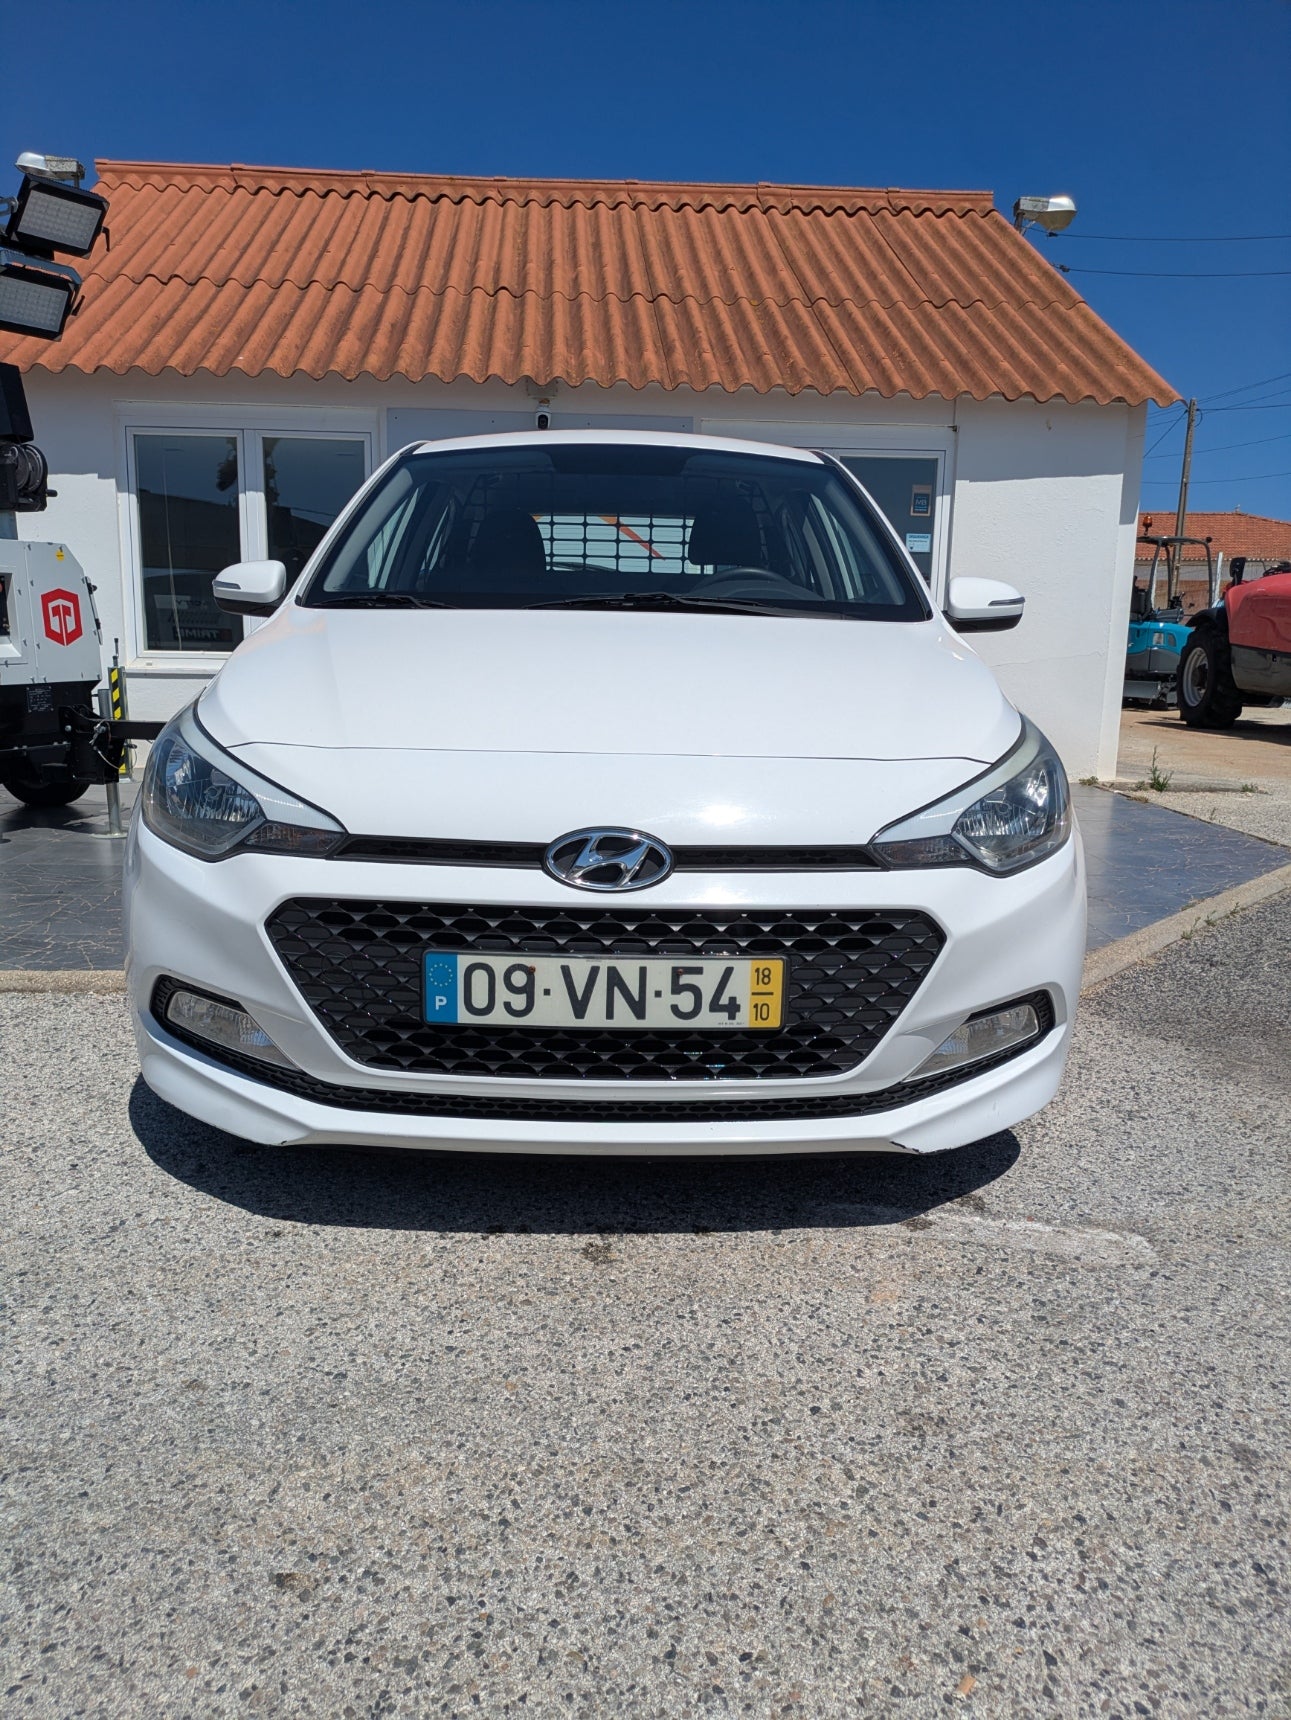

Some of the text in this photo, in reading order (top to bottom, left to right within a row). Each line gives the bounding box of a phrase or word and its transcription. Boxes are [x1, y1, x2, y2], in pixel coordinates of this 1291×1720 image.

[754, 967, 772, 986] 18
[435, 995, 447, 1011] P
[752, 1002, 770, 1022] 10
